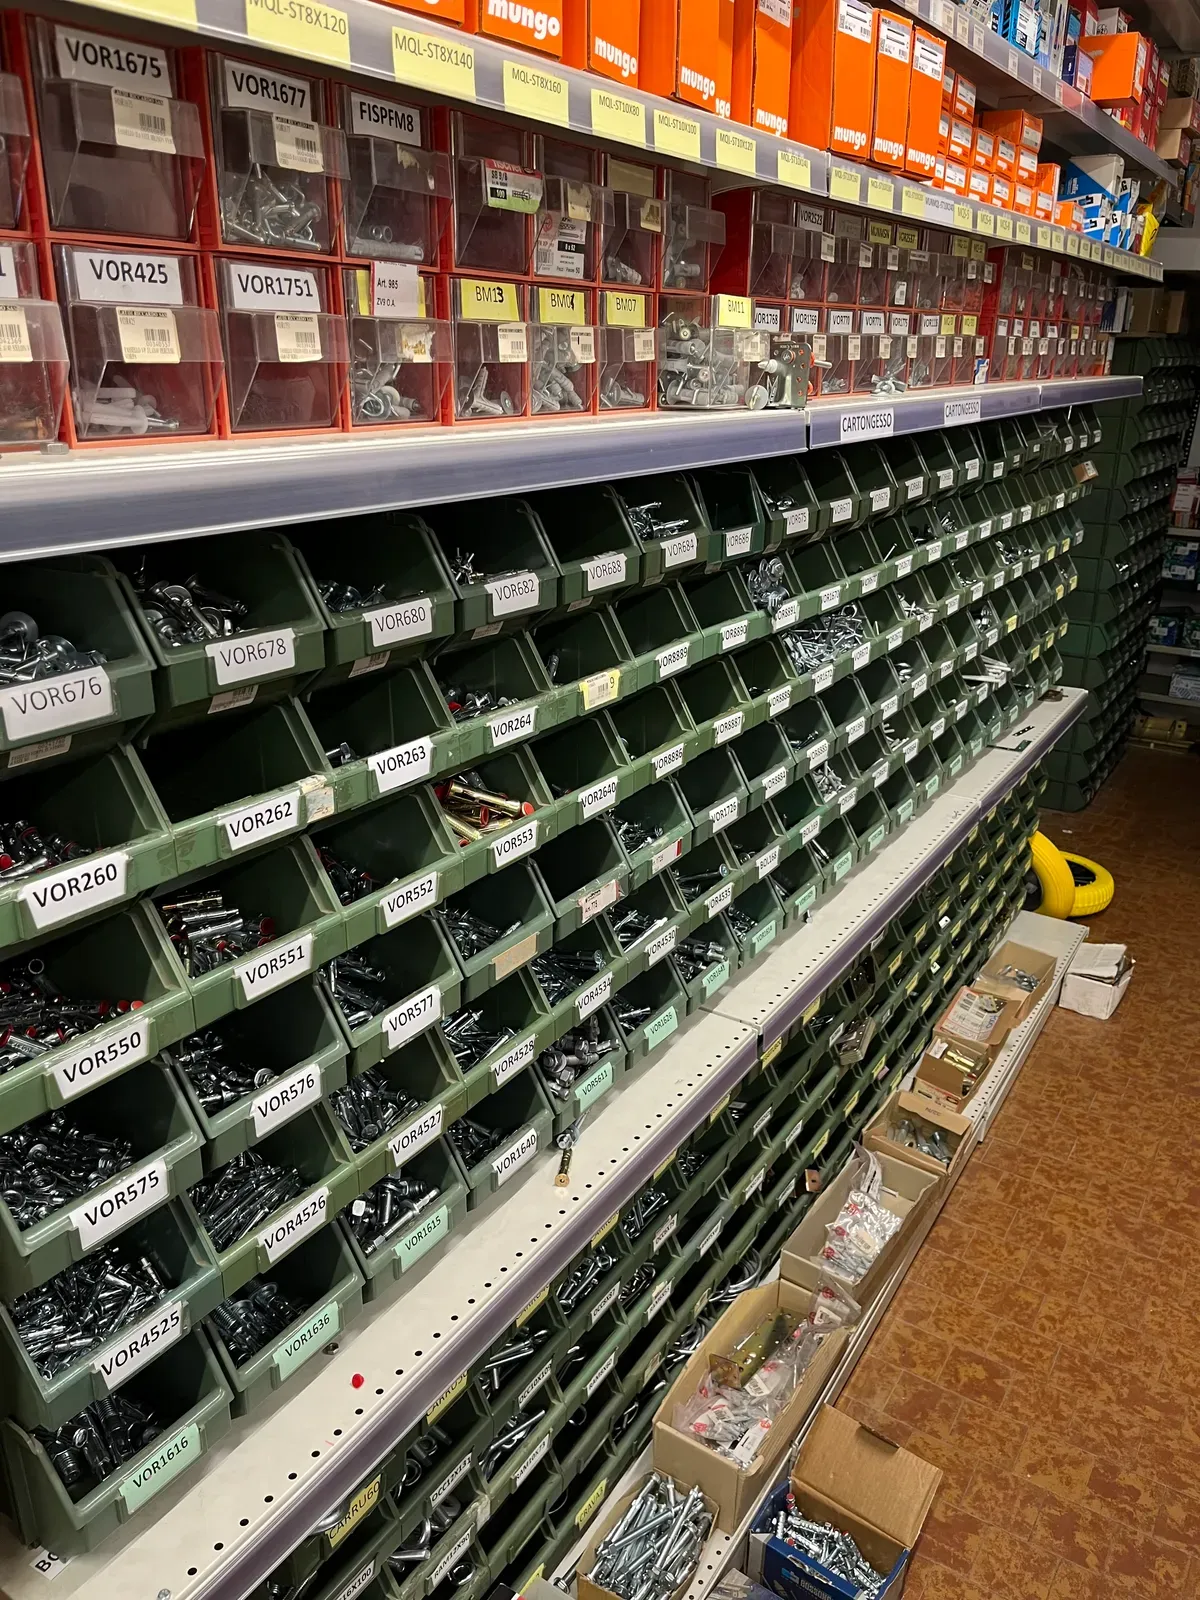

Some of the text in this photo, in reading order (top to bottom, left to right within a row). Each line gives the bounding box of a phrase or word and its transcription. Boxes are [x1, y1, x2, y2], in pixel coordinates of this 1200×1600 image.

[487, 0, 561, 40] mungo
[64, 37, 162, 79] VOR1675
[394, 33, 473, 70] MQL-ST8X140
[594, 36, 638, 78] mungo
[231, 70, 307, 109] VOR1677
[511, 67, 562, 94] MQL-ST8X160
[680, 66, 716, 101] mungo
[359, 101, 414, 133] FISPFM8
[598, 94, 640, 117] MQL-ST10X80
[756, 108, 788, 138] mungo
[834, 126, 868, 151] mungo
[874, 137, 905, 160] mungo
[907, 147, 936, 171] mungo
[88, 258, 169, 285] VOR425
[237, 272, 314, 298] VOR1751
[615, 297, 637, 312] BM07
[727, 299, 745, 314] BM11
[842, 413, 892, 433] CARTONGESSO
[945, 401, 980, 418] CARTONGESSO
[666, 538, 695, 558] VOR684
[725, 531, 750, 548] VOR686
[588, 559, 623, 581] VOR688
[494, 578, 537, 602] VOR682
[374, 606, 427, 633] VOR680
[219, 637, 287, 668] VOR678
[11, 676, 103, 716] VOR676
[493, 713, 533, 739] VOR264
[376, 745, 427, 776] VOR263
[580, 781, 617, 808] VOR2640
[229, 801, 293, 839] VOR262
[495, 827, 534, 857] VOR553
[32, 862, 118, 908] VOR260
[386, 878, 434, 913] VOR552
[648, 928, 676, 957] VOR4530
[245, 944, 306, 985] VOR551
[577, 976, 611, 1012] VOR4534
[388, 993, 435, 1032] VOR577
[62, 1031, 142, 1084] VOR550
[494, 1039, 536, 1078] VOR4528
[257, 1074, 315, 1119] VOR576
[392, 1110, 443, 1156] VOR4527
[495, 1134, 537, 1176] VOR1640
[84, 1169, 160, 1227] VOR575
[264, 1195, 327, 1251] VOR4526
[404, 1216, 442, 1253] VOR1615
[100, 1310, 181, 1379] VOR4525
[284, 1313, 331, 1358] VOR1636
[131, 1436, 190, 1489] VOR1616
